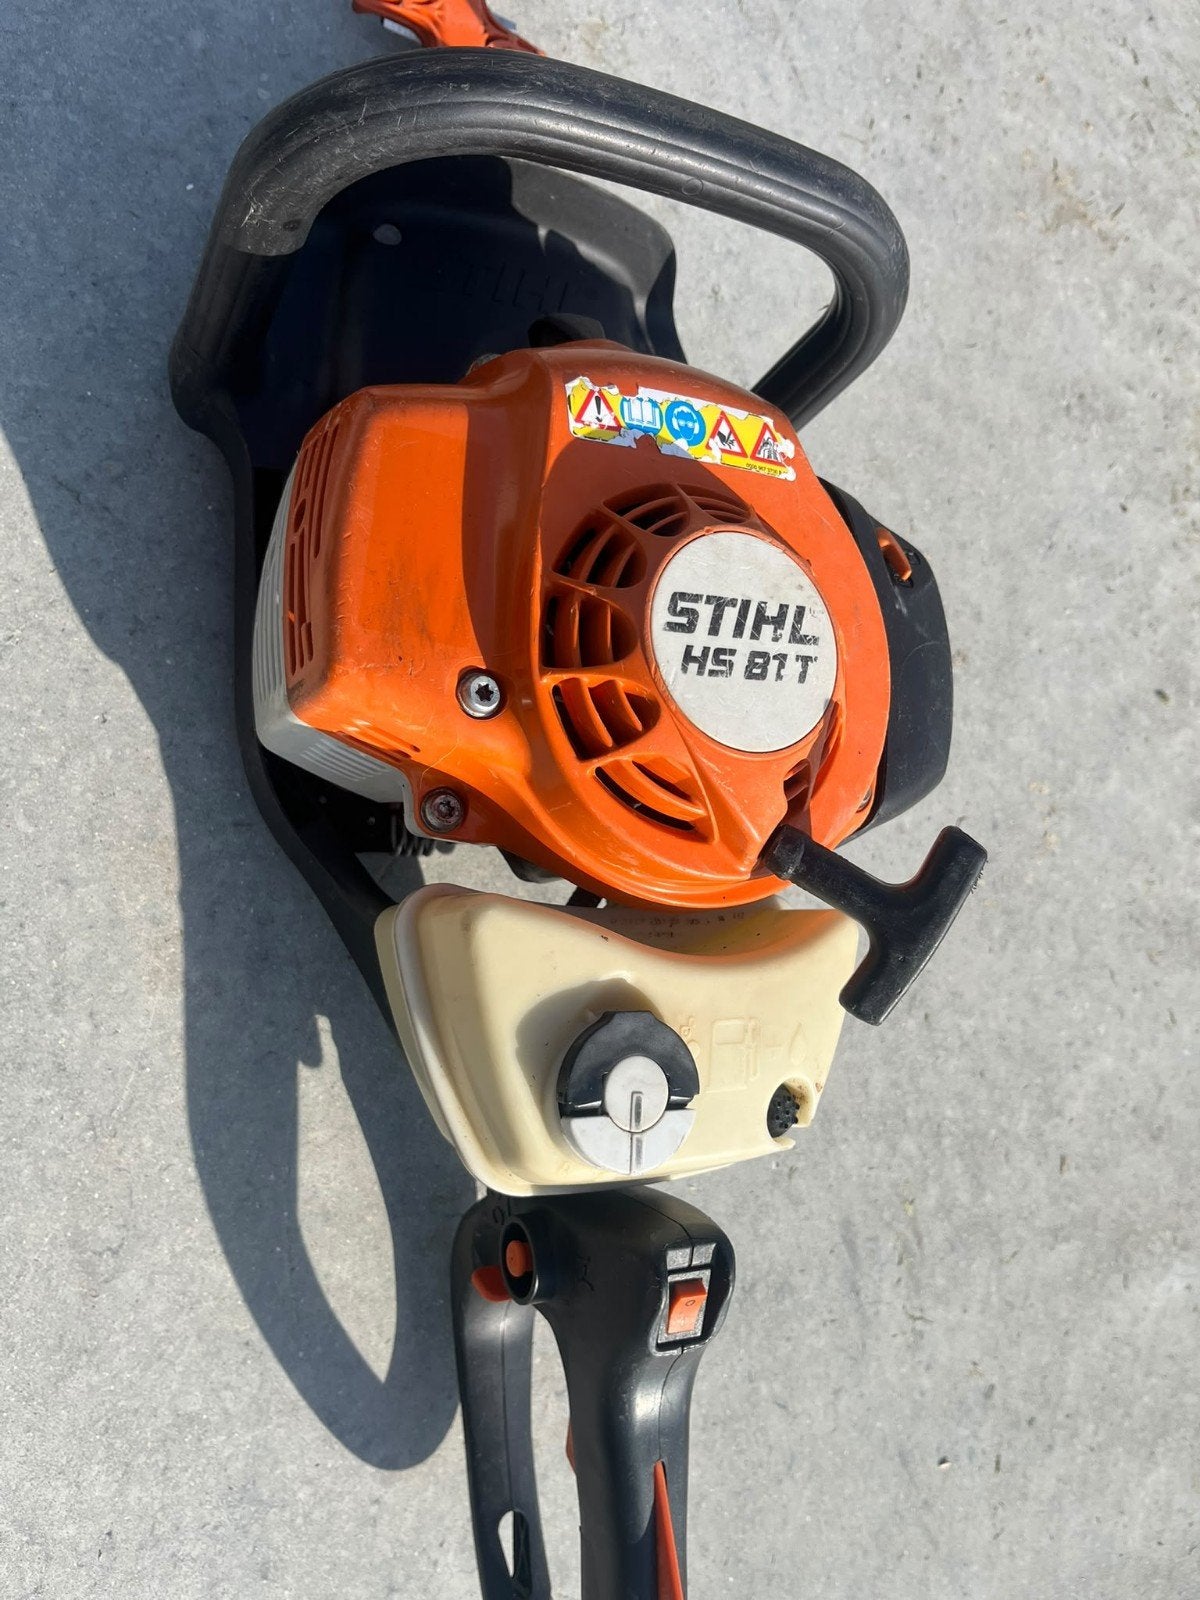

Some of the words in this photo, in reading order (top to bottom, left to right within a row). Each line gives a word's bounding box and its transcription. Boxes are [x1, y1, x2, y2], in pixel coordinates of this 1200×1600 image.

[663, 591, 820, 646] STIHL
[681, 644, 737, 678] HS
[744, 650, 788, 682] 81
[795, 654, 818, 684] T
